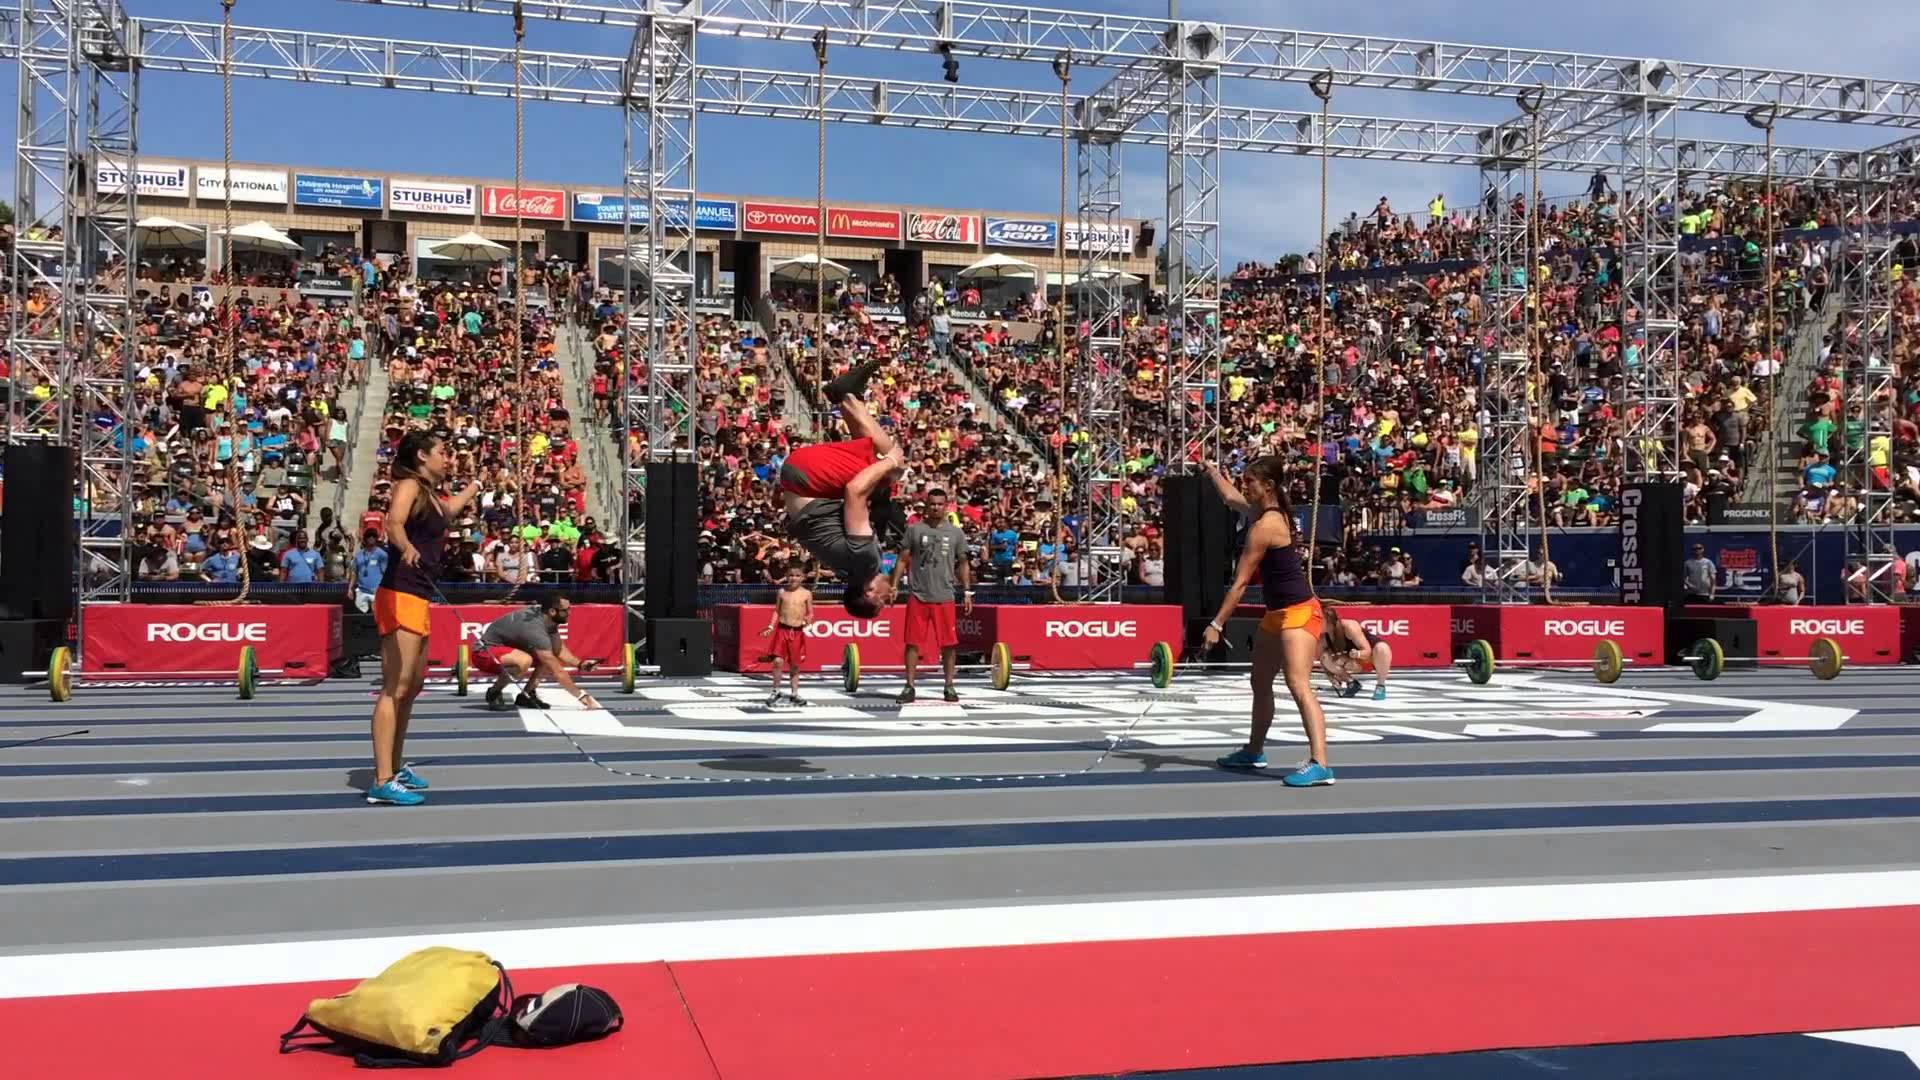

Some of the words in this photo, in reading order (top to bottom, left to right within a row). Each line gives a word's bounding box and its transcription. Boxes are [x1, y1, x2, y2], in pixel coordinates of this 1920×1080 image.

[392, 187, 472, 205] STUBHUB!
[415, 203, 448, 211] CENTER
[767, 213, 816, 226] TOYOTA
[851, 220, 896, 230] McDonald's
[1002, 222, 1047, 233] BUD
[992, 231, 1053, 242] LIGHT
[863, 302, 892, 311] Reebok
[950, 309, 978, 318] Reebok
[1426, 510, 1466, 521] CrossFit
[1722, 509, 1771, 518] PROGENEX
[1621, 488, 1643, 604] CrossFit
[147, 622, 267, 642] ROGUE
[1045, 620, 1137, 638] ROGUE
[1360, 619, 1409, 636] GUE
[1544, 619, 1625, 636] ROGUE
[1789, 619, 1865, 635] ROGUE
